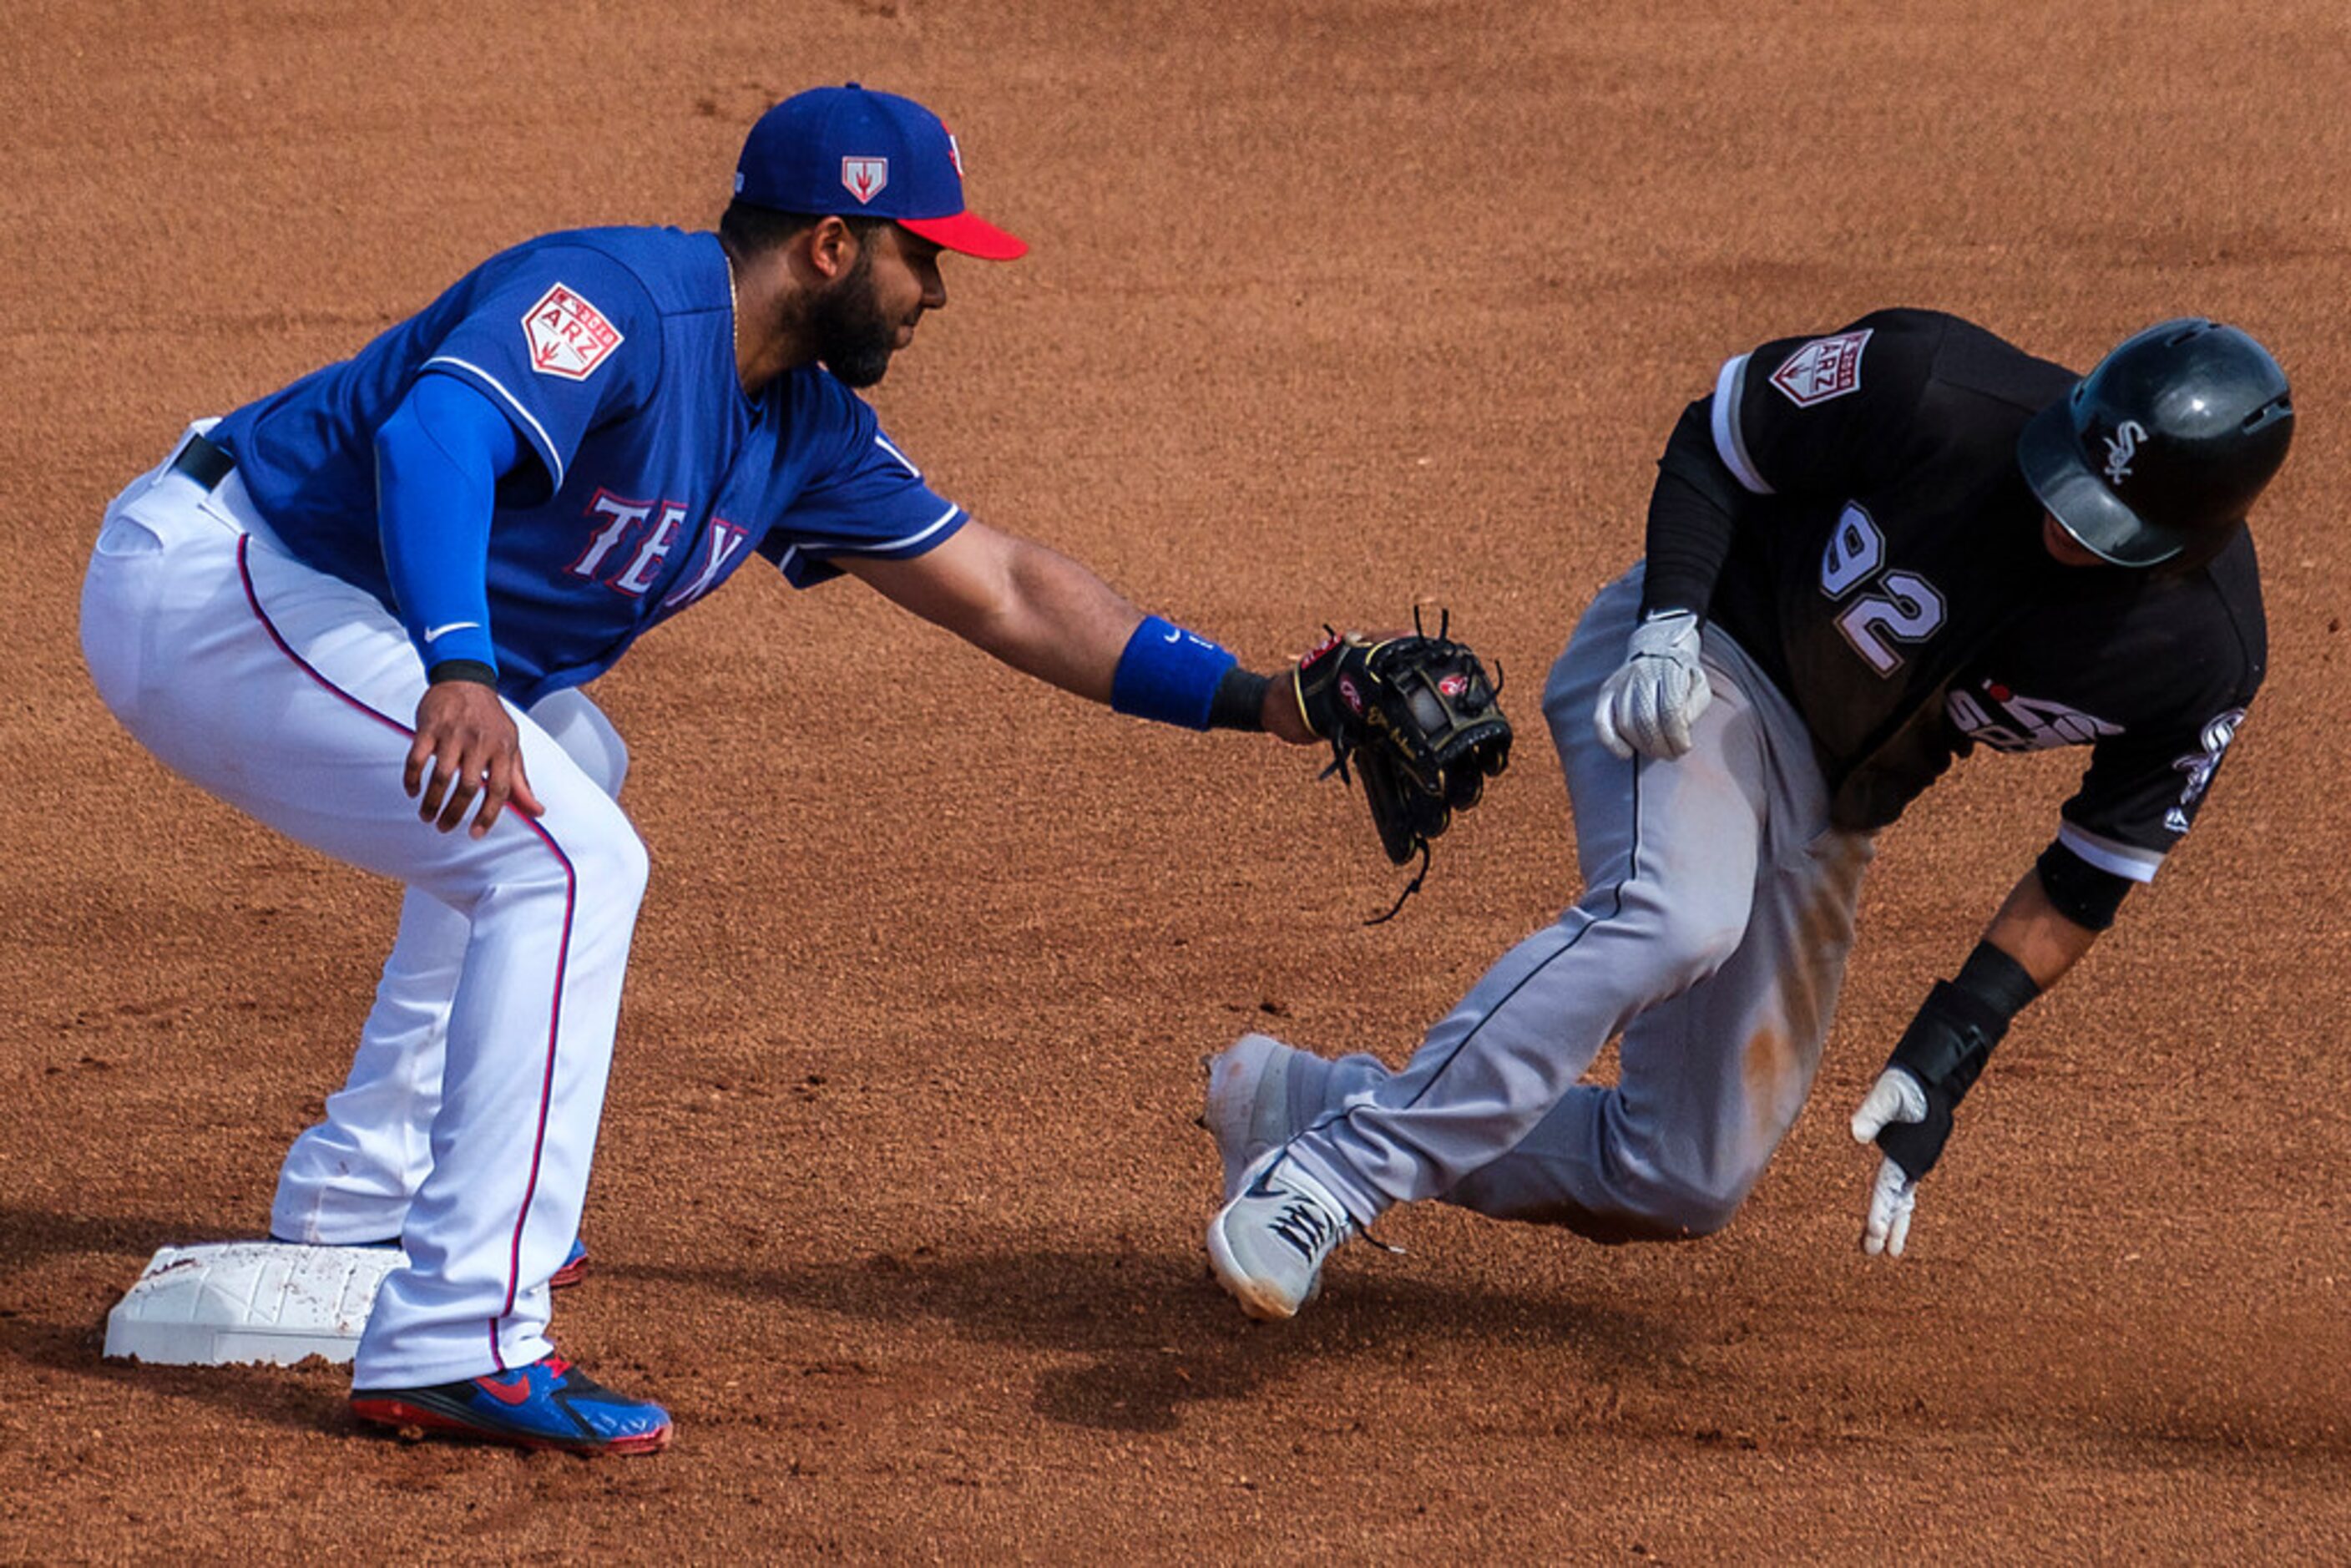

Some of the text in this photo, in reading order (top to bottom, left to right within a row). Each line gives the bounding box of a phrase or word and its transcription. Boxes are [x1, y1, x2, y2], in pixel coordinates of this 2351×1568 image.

[540, 308, 599, 361] ARZ
[1815, 345, 1840, 392] ARZ
[1819, 499, 1948, 680] 92
